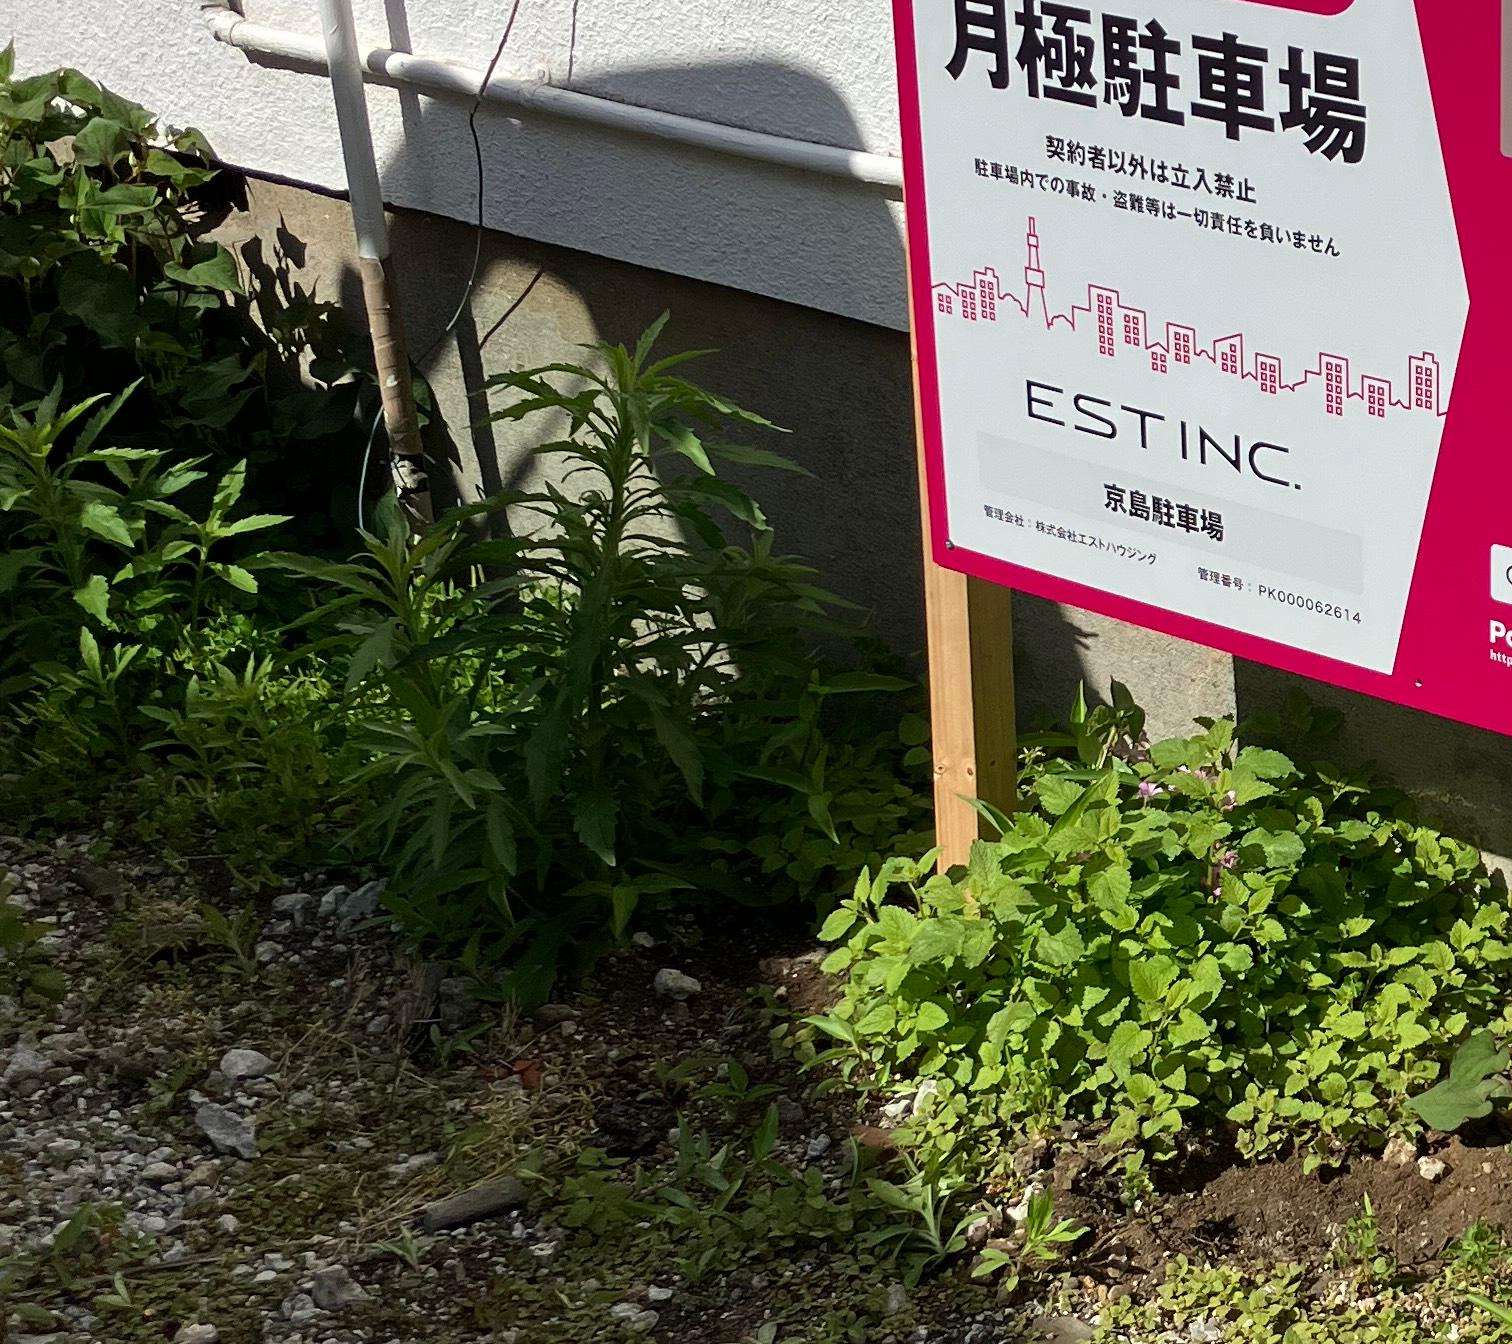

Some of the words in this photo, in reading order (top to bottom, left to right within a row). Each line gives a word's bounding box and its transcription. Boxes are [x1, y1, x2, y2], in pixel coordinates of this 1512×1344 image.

[1045, 135, 1257, 204] 契約者以外は立入禁止
[1103, 482, 1225, 543] 京島駐車場
